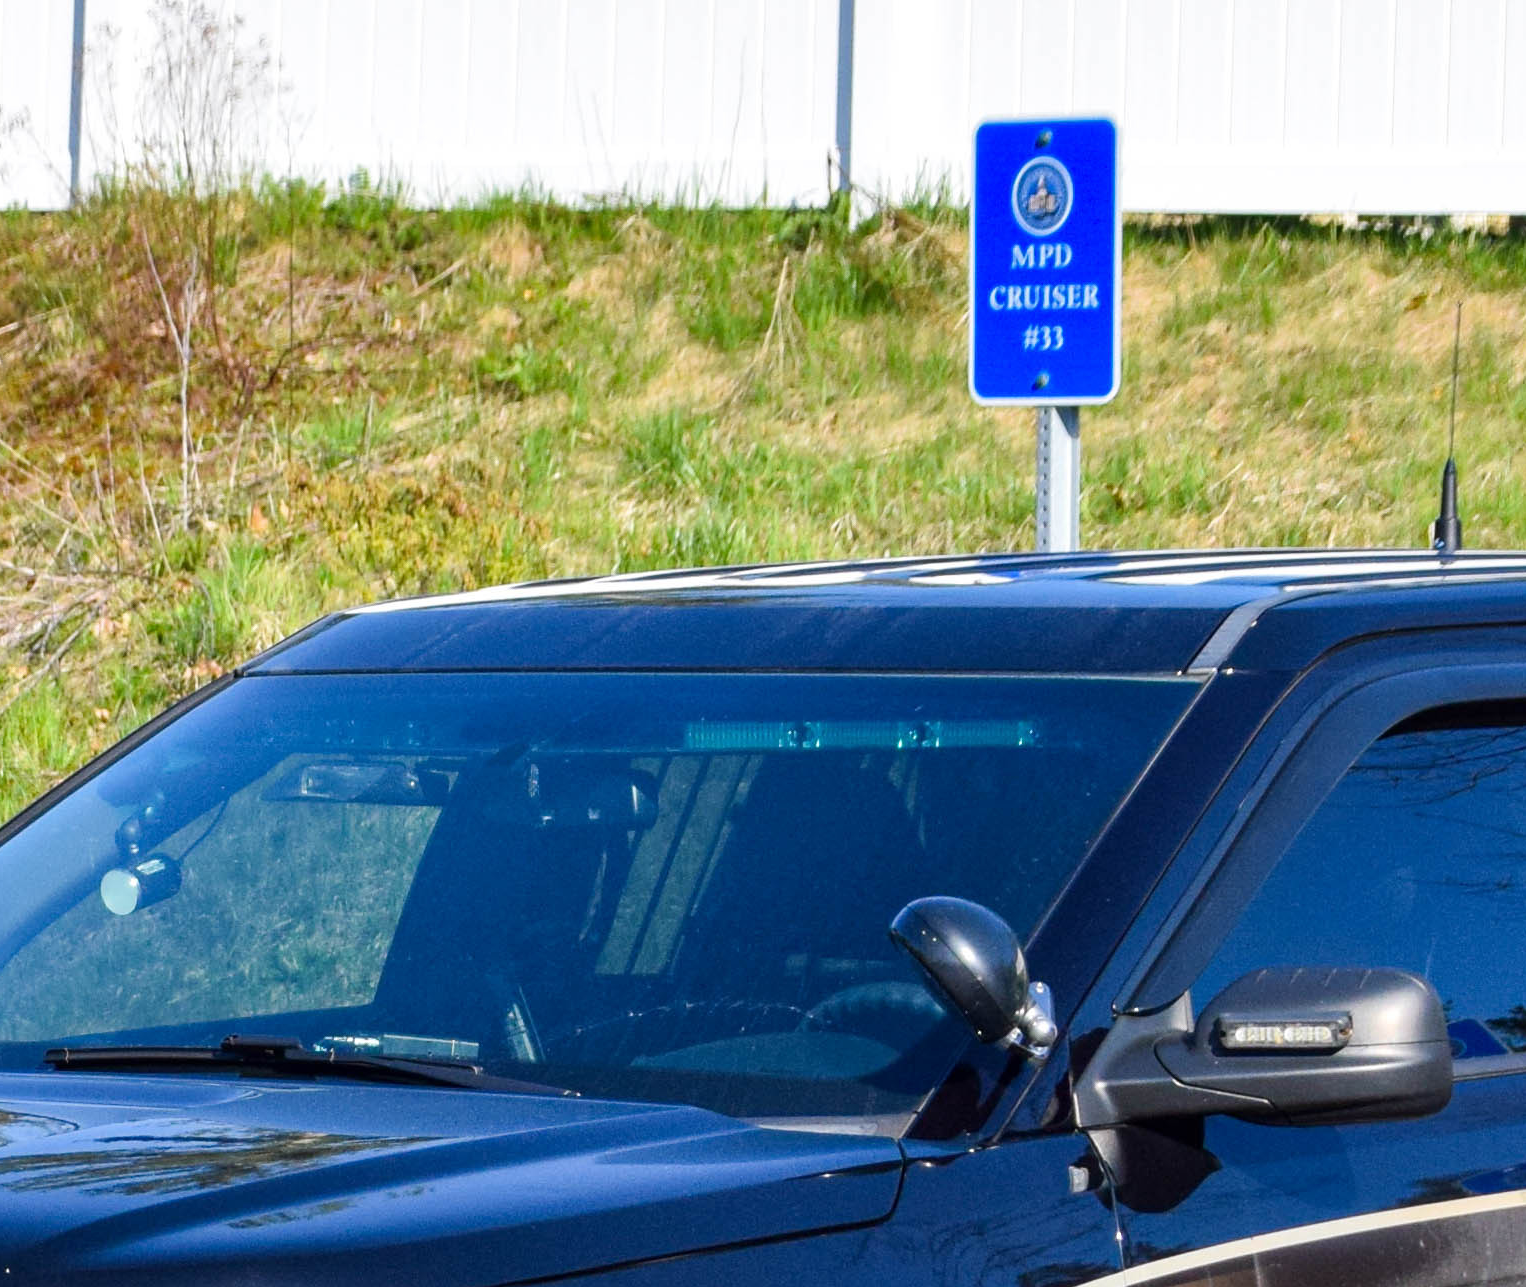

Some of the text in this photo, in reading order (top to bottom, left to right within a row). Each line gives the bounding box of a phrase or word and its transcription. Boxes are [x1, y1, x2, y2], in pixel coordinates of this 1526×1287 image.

[1010, 244, 1072, 269] MPD
[989, 284, 1099, 310] CRUISER
[1023, 325, 1064, 350] #33
